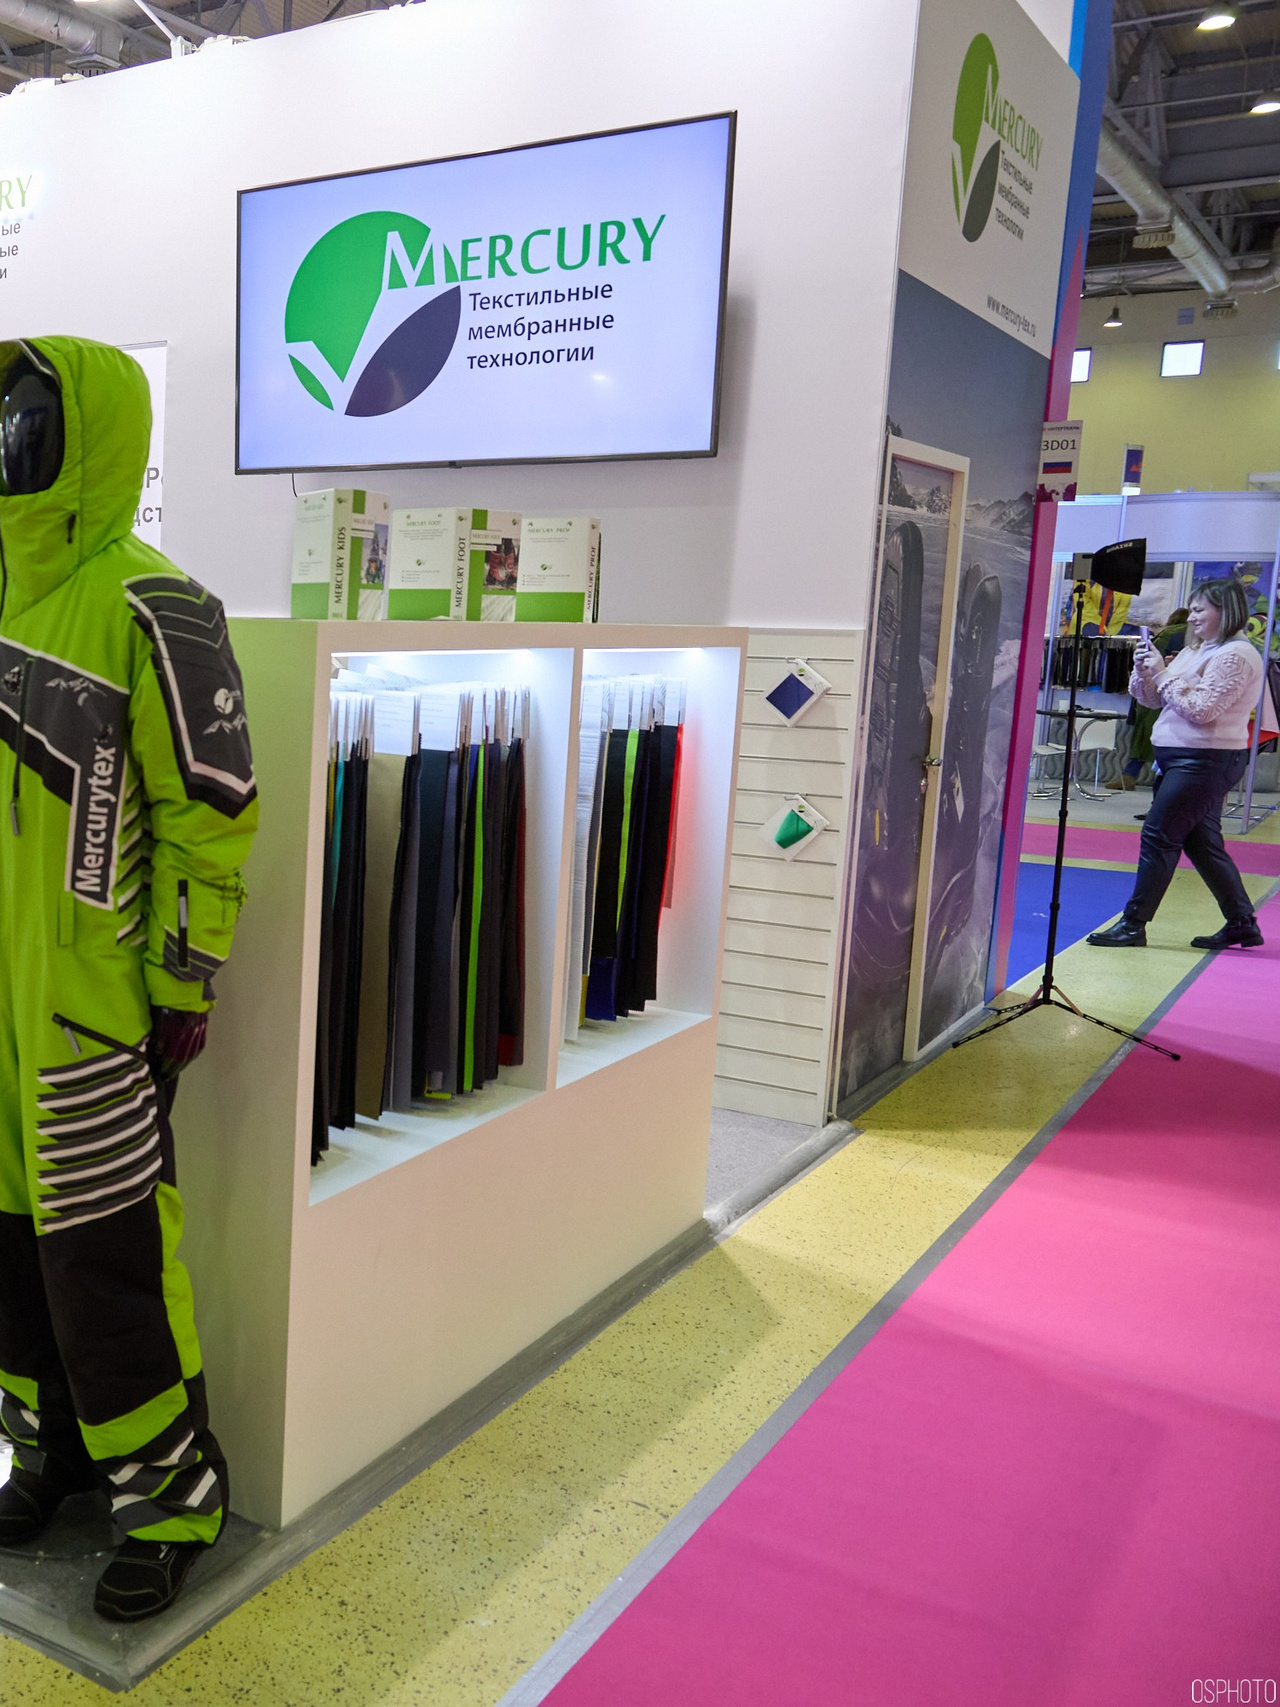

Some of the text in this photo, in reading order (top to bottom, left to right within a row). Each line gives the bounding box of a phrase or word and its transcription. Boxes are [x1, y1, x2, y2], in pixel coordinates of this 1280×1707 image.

[982, 65, 1043, 171] MERCURY
[1000, 150, 1033, 195] Текстильные
[382, 214, 667, 291] MERCURY
[468, 282, 614, 311] Текстильные
[467, 312, 615, 342] мембранные
[467, 343, 595, 370] технологии
[1041, 439, 1077, 451] 3D01
[337, 526, 347, 550] KIDS
[457, 537, 467, 561] FOOT
[334, 555, 345, 604] MERCURY
[455, 565, 465, 608] MERCURY
[75, 744, 116, 892] Mercurytex
